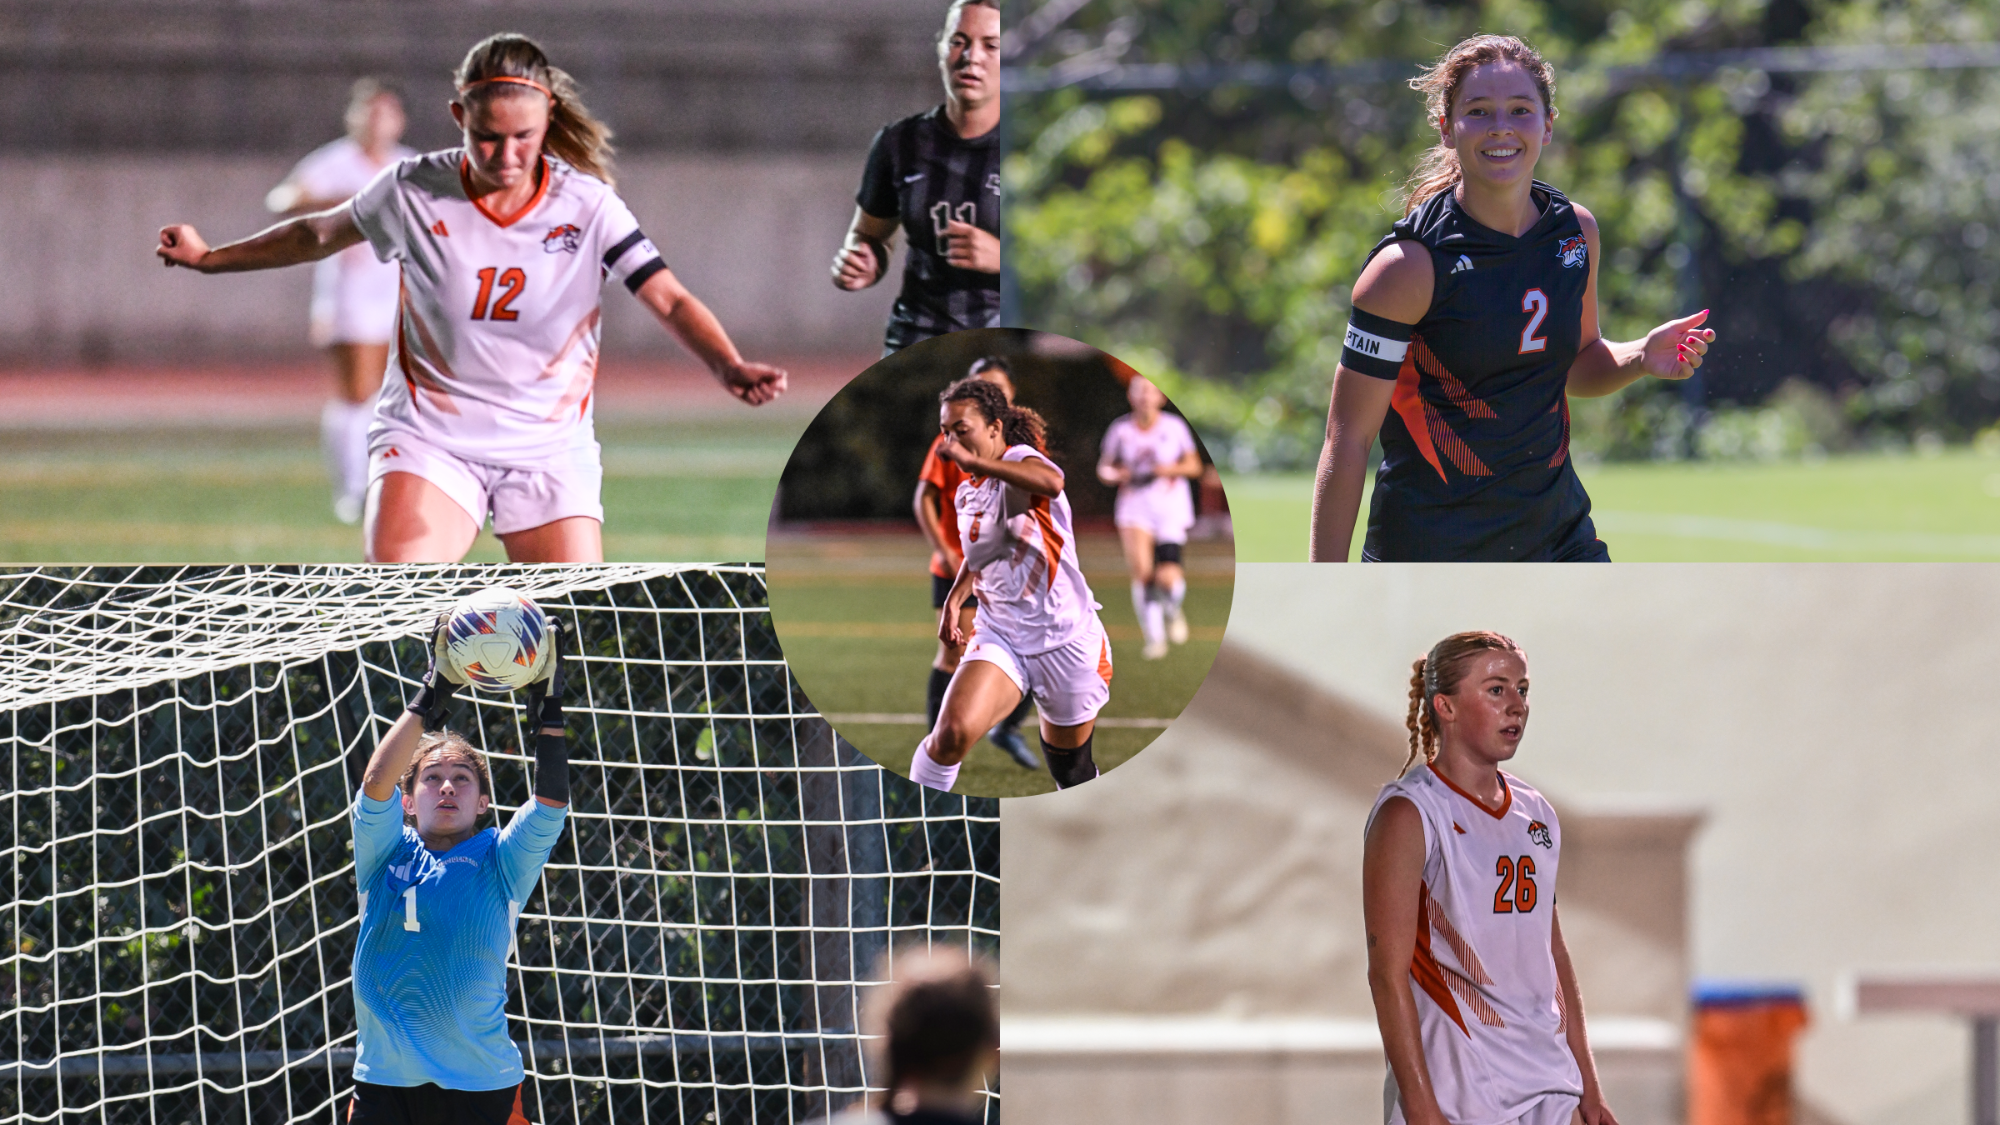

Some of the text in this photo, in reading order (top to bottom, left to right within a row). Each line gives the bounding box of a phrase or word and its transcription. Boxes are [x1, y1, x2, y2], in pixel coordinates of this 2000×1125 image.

[470, 266, 527, 321] 12
[1518, 288, 1549, 355] 2
[969, 510, 984, 543] 6
[402, 885, 421, 933] 1
[1493, 855, 1538, 914] 26
